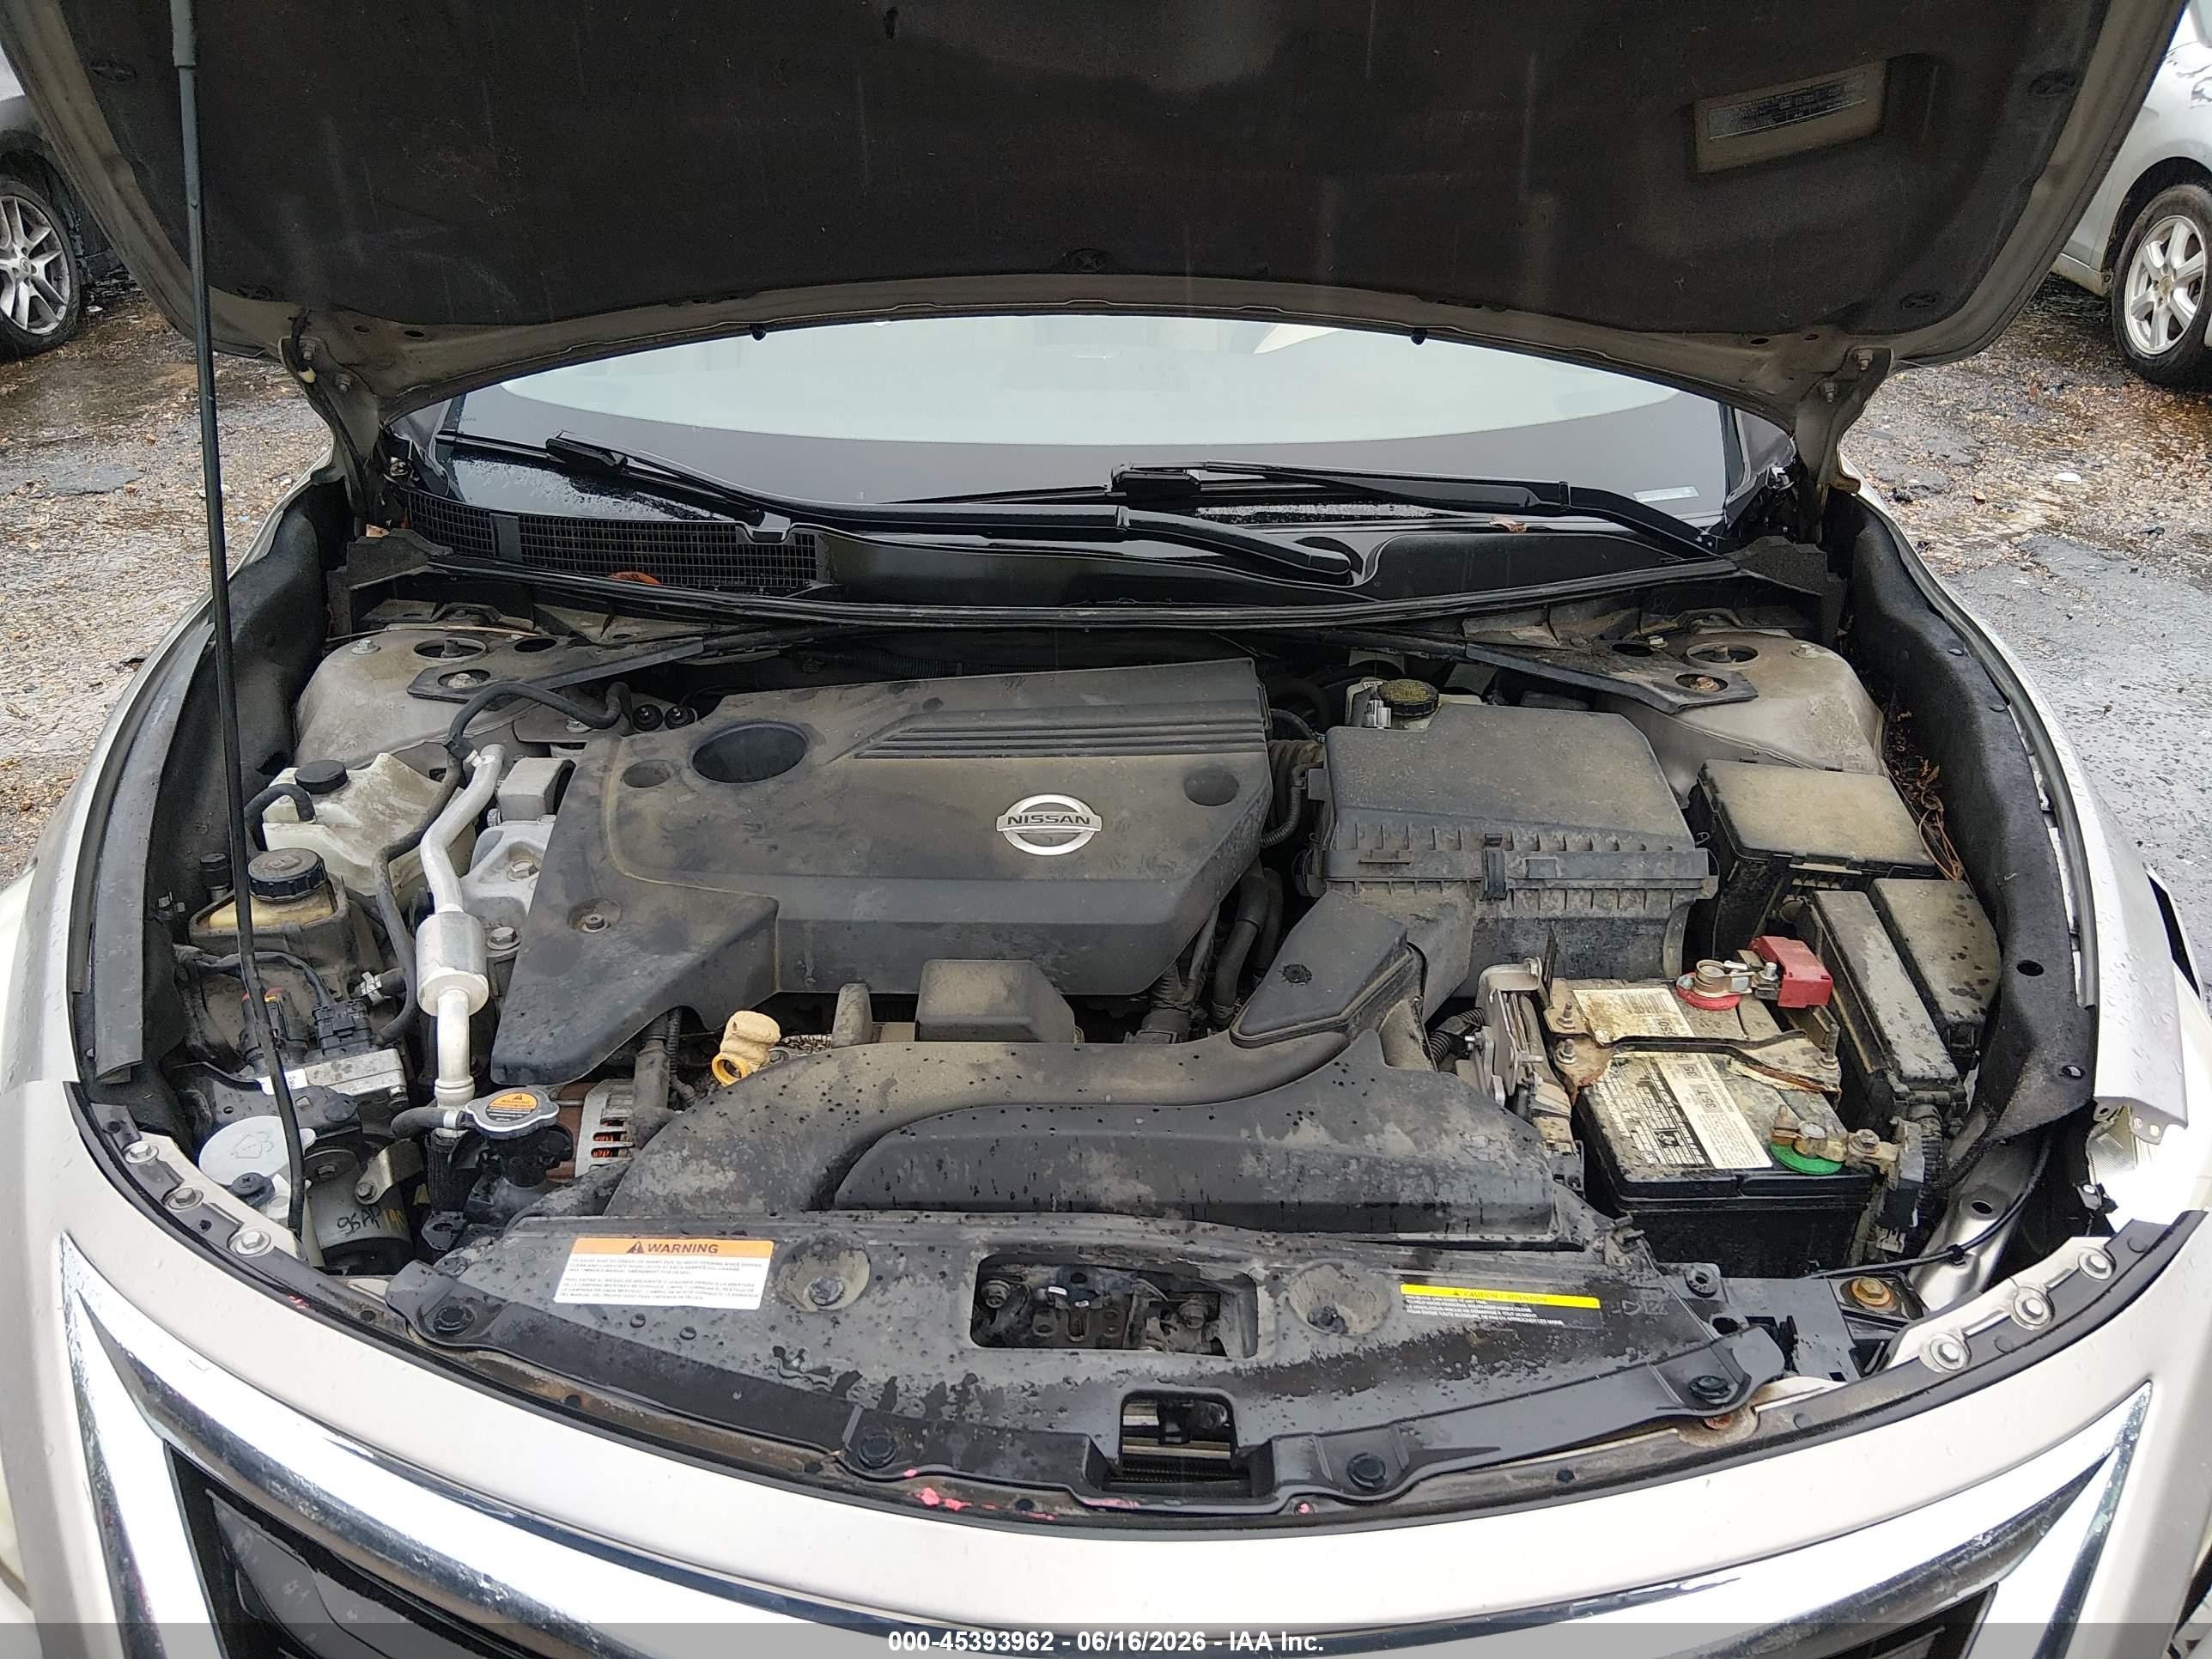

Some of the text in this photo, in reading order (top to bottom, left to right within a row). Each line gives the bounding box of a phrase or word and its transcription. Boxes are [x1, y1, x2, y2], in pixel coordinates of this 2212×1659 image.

[1007, 814, 1090, 825] NISSAN
[1696, 1090, 1717, 1109] 35-T
[647, 1242, 720, 1255] WARNING
[1463, 1291, 1498, 1299] CAUTION
